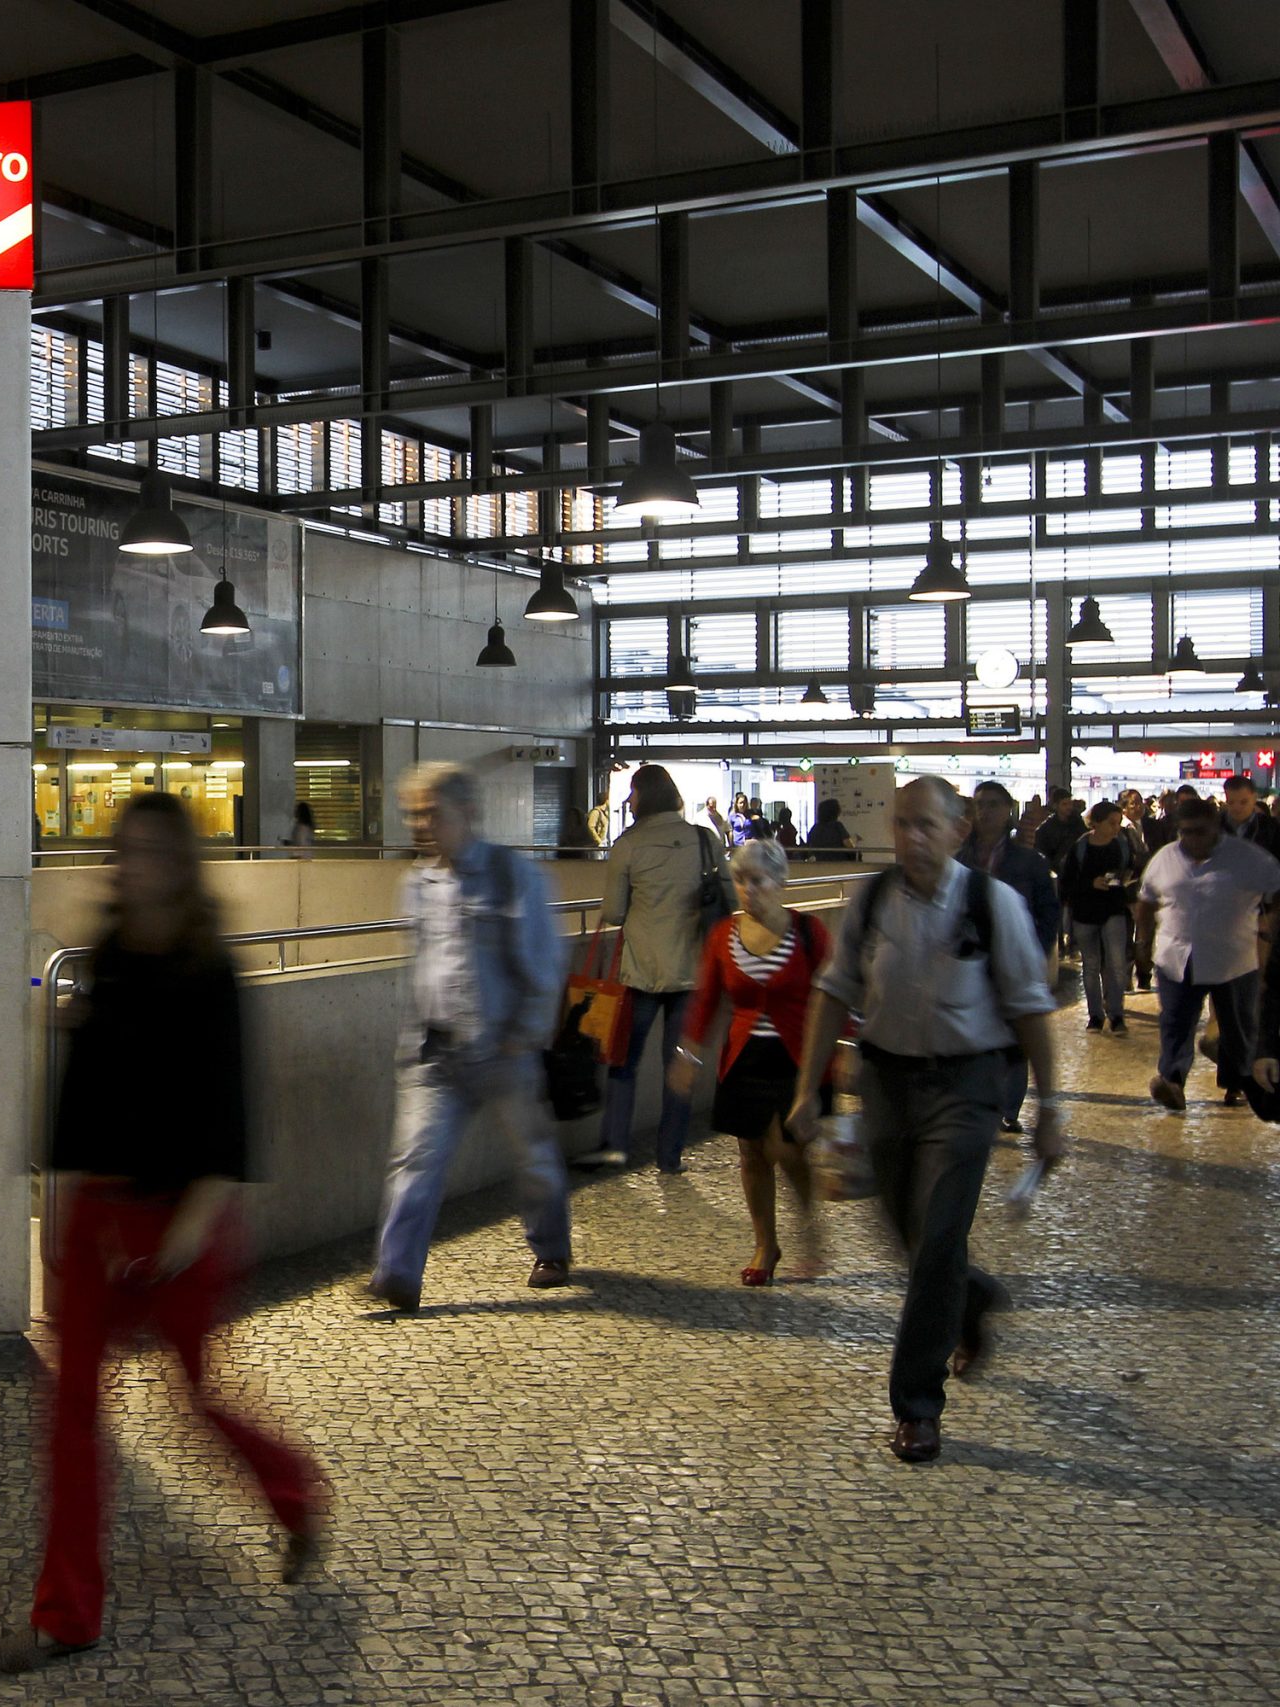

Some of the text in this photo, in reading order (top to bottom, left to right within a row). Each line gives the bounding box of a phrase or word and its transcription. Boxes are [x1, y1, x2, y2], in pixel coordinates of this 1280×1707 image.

[41, 489, 86, 509] CARRINHA
[59, 512, 119, 541] TOURING
[32, 533, 69, 557] ORTS
[33, 603, 65, 623] ERTA
